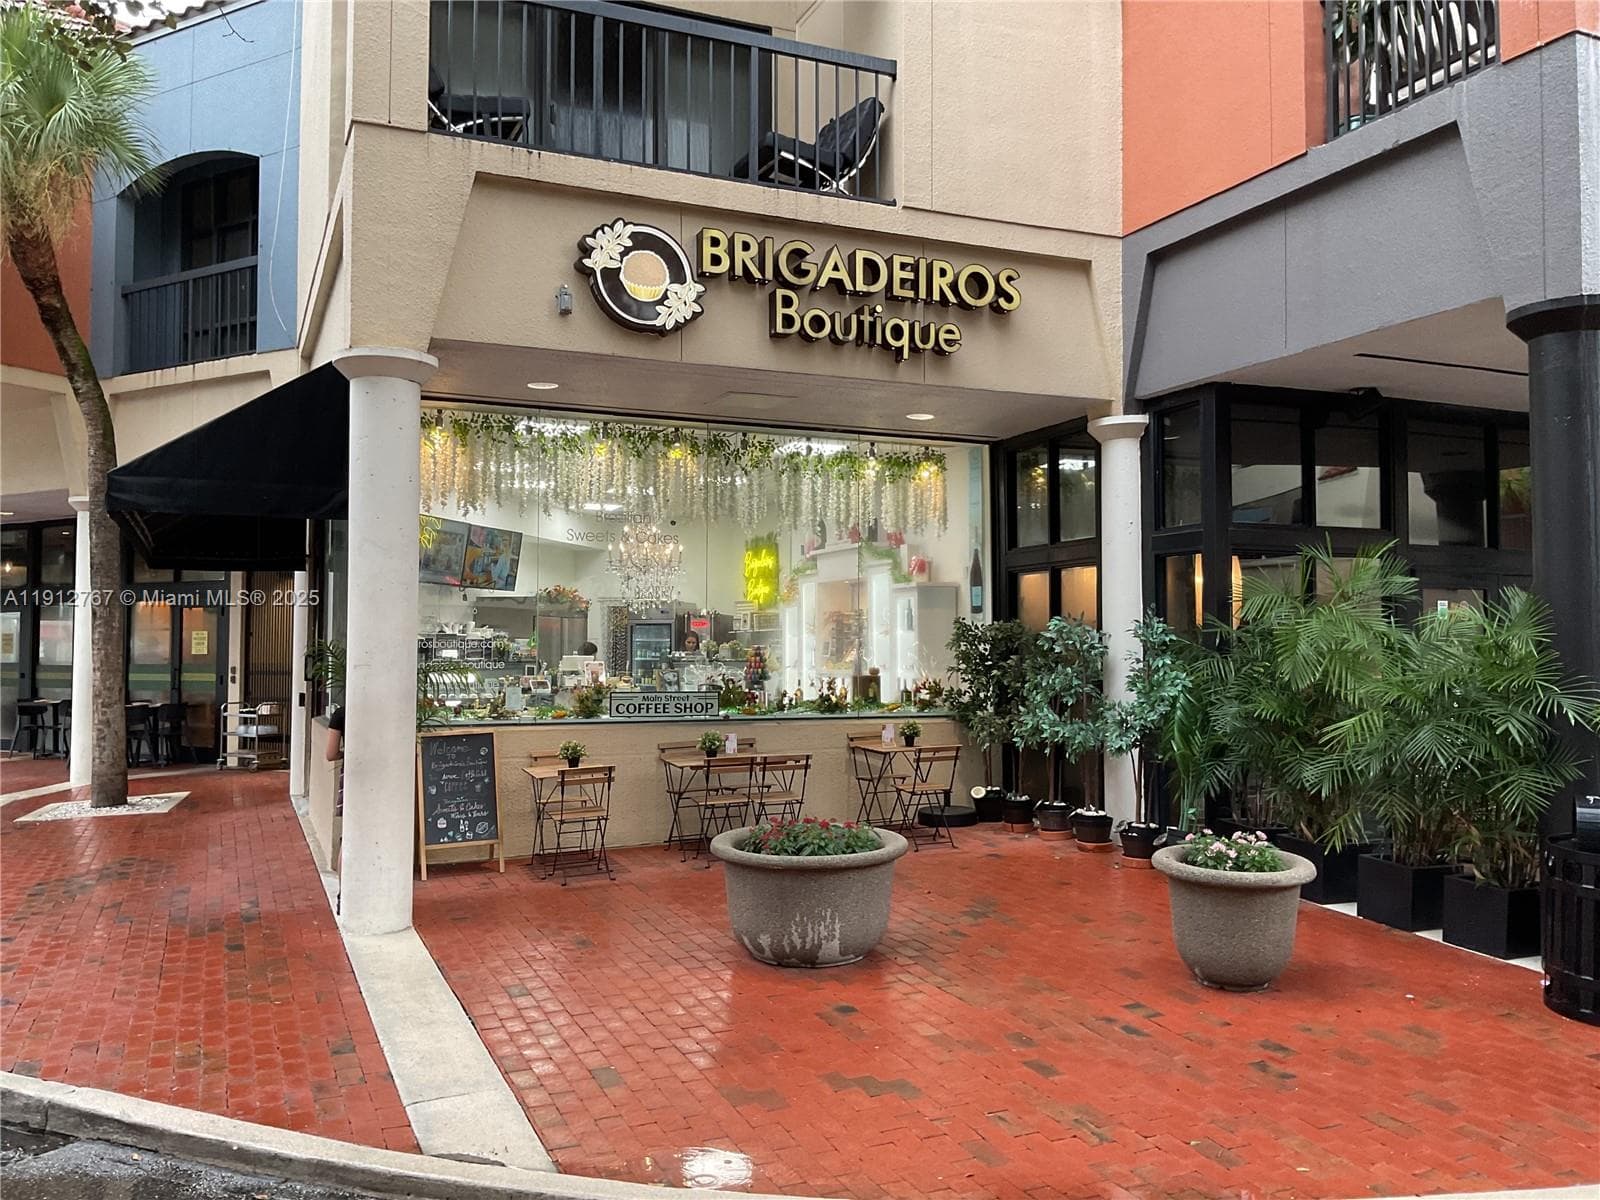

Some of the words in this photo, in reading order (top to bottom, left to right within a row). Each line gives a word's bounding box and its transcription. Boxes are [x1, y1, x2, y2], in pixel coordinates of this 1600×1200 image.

[698, 228, 1021, 312] BRIGADEIROS
[772, 288, 962, 361] Boutique
[566, 528, 616, 543] Sweets
[621, 531, 631, 543] &
[635, 531, 679, 545] Cakes
[641, 694, 663, 703] Main
[664, 694, 690, 702] Street
[615, 702, 671, 715] COFFEE
[674, 702, 714, 714] SHOP
[430, 741, 473, 755] Welcome
